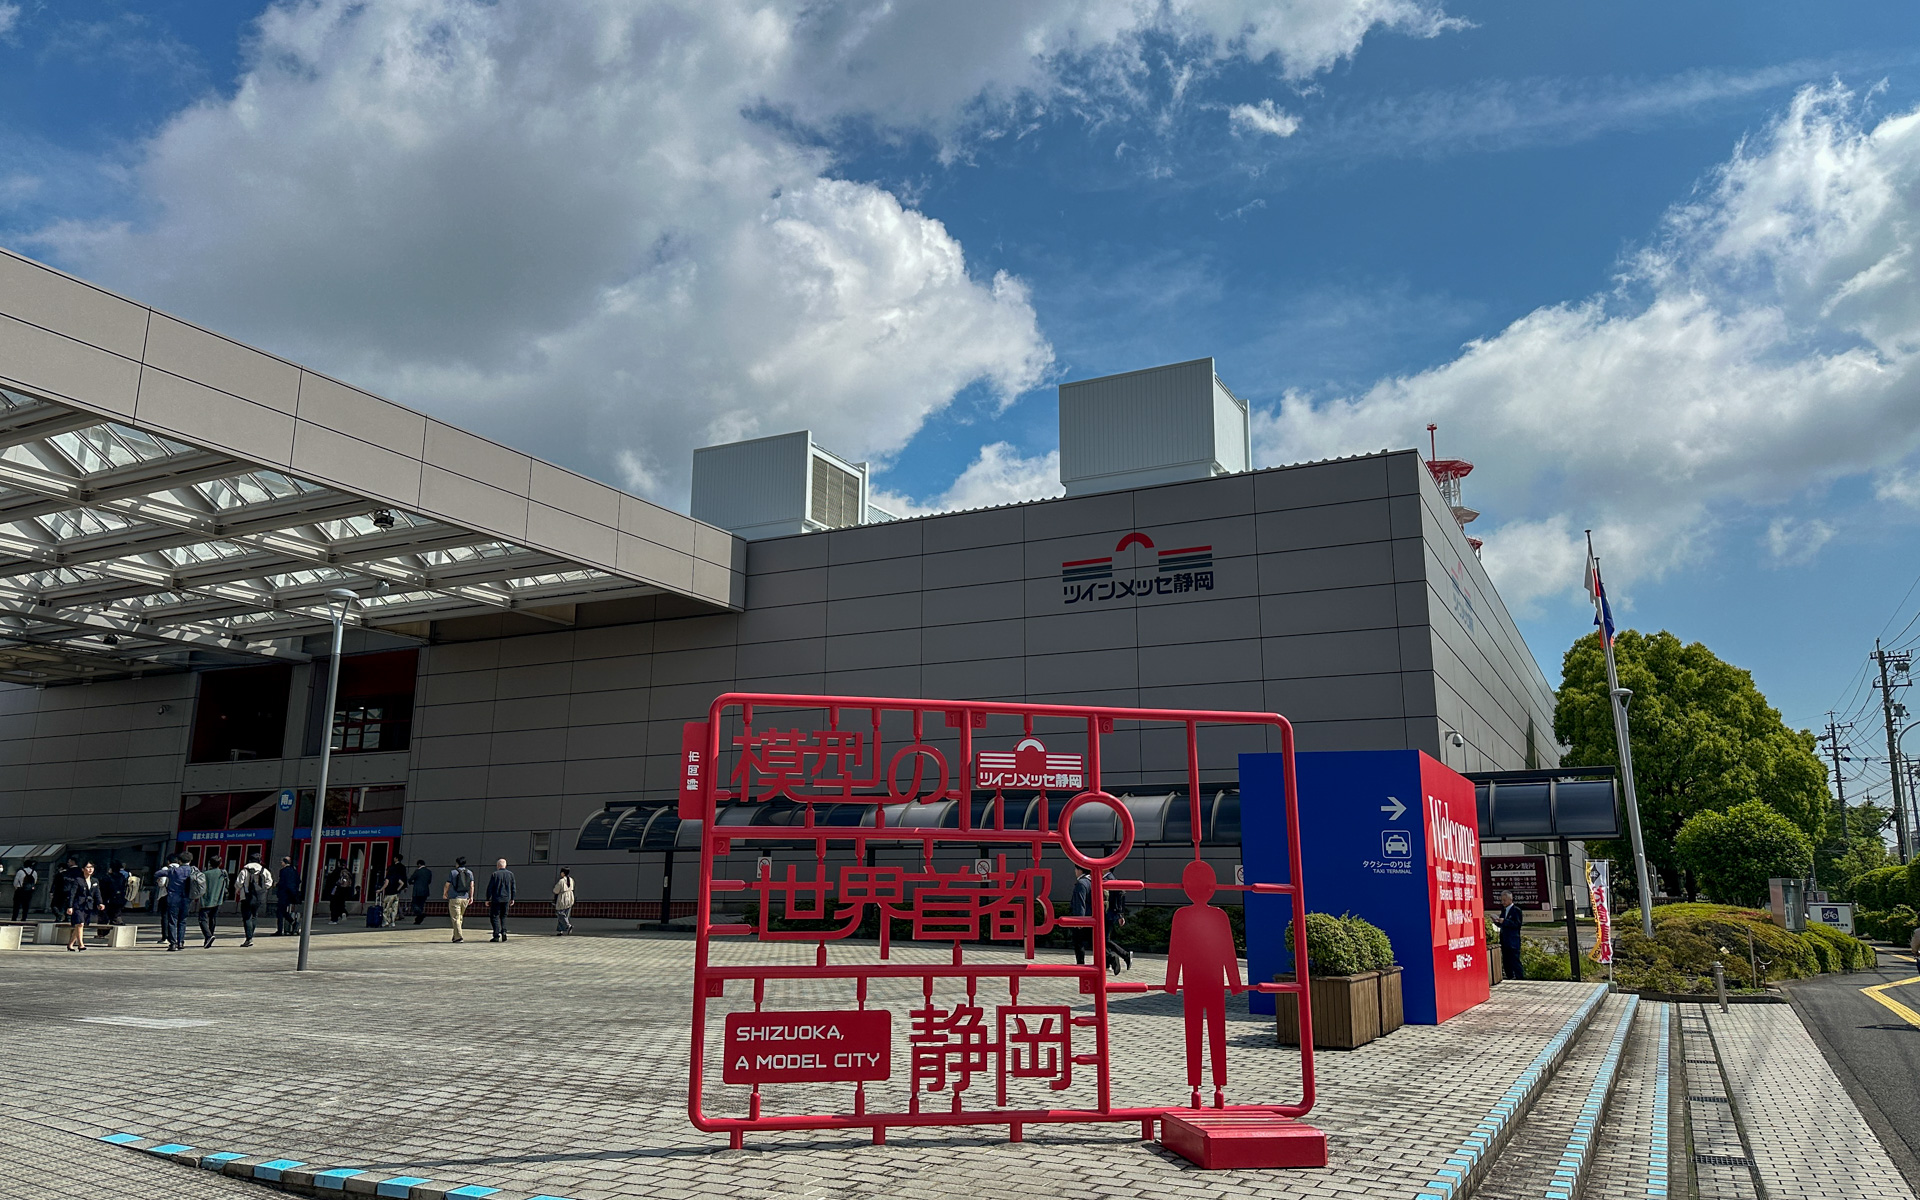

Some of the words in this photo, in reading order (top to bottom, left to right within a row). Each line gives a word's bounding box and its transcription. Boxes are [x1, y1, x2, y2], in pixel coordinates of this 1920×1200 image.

[1063, 571, 1214, 604] ツインメッセ静岡
[686, 750, 700, 791] 静岡市
[731, 727, 949, 805] 模型の
[979, 772, 1082, 788] ツインメッセ静岡
[1427, 795, 1476, 867] Welcome
[1362, 860, 1412, 869] タクシーのりば
[752, 853, 1055, 960] 世界首都
[736, 1024, 845, 1042] SHIZUOKA,
[735, 1055, 749, 1070] A
[756, 1054, 827, 1070] MODEL
[834, 1052, 880, 1068] CITY
[909, 1003, 1071, 1107] 静岡
